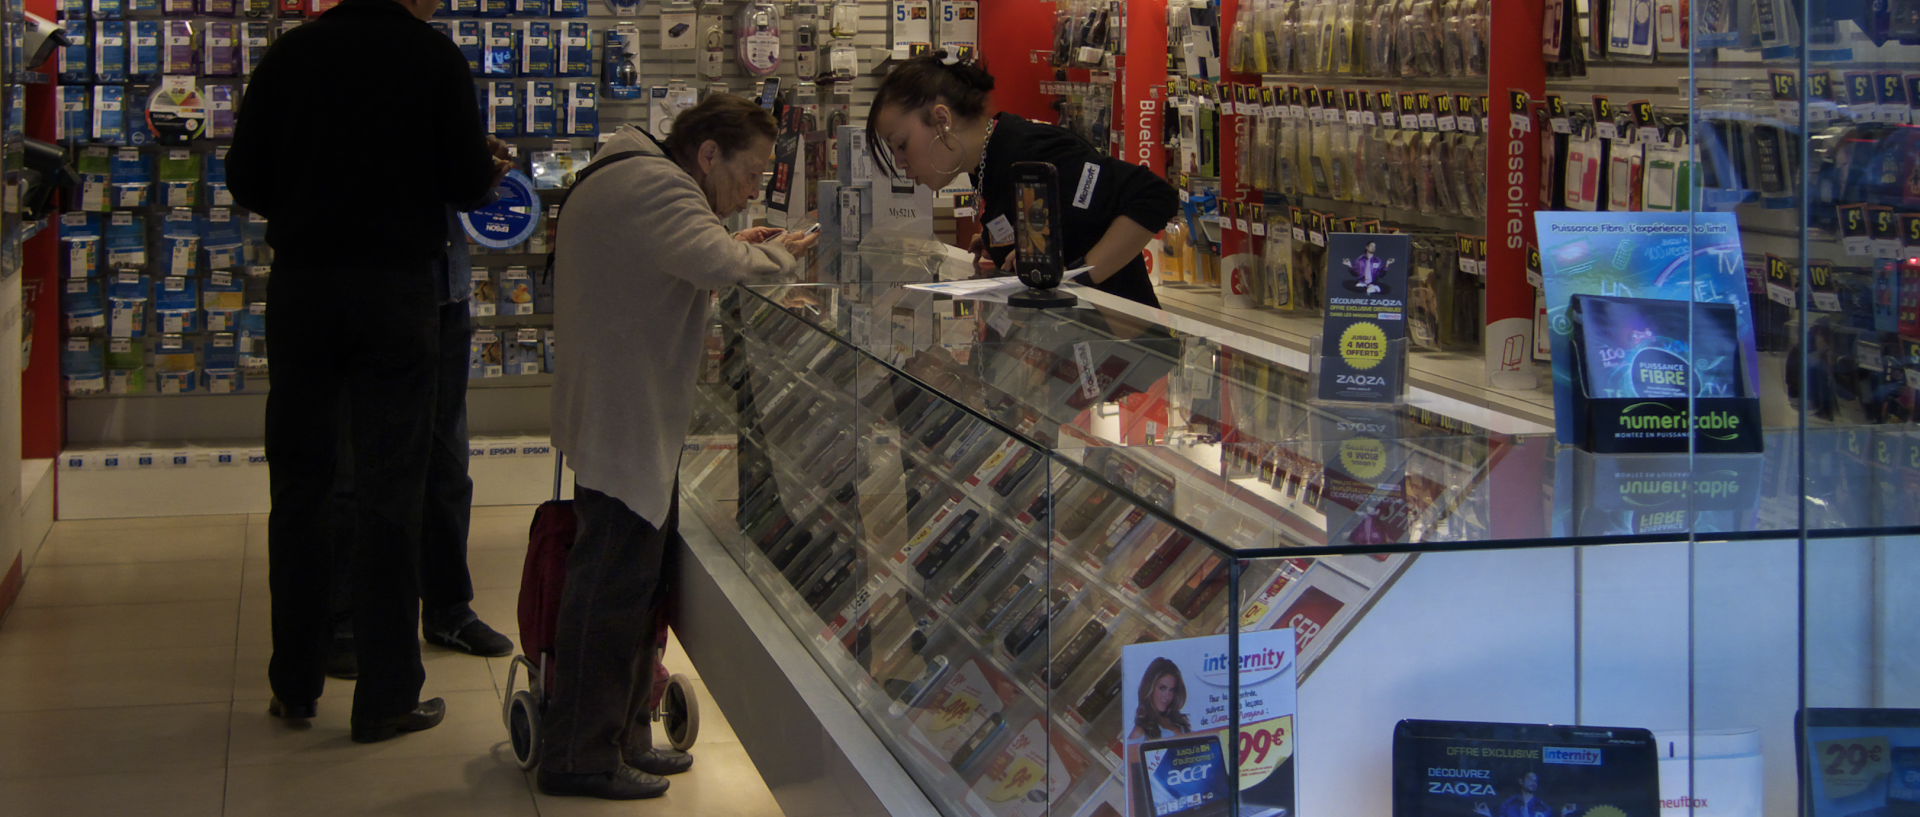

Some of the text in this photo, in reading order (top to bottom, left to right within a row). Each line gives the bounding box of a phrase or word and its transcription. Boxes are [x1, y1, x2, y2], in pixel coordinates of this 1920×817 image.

[897, 5, 905, 21] 5
[944, 6, 953, 21] 5
[1775, 75, 1793, 94] 15€
[1808, 75, 1826, 95] 15€
[1856, 76, 1868, 96] 5€
[1885, 76, 1898, 97] 5€
[1078, 166, 1096, 206] Microsoft
[889, 208, 917, 218] My521X
[1849, 209, 1861, 230] 5€
[1551, 223, 1599, 232] Puissance
[1878, 212, 1891, 232] 5€
[1706, 248, 1742, 275] TV
[1640, 362, 1684, 371] PUISSANCE
[1336, 374, 1386, 386] ZAOZA
[1640, 369, 1686, 386] FIBRE
[1706, 382, 1728, 395] TV
[490, 447, 517, 456] EPSON
[1446, 747, 1600, 764] OFFRE EXCLUSIVE internity
[1825, 743, 1882, 776] 29€
[1167, 763, 1213, 786] acer
[1428, 781, 1497, 796] ZAOZA
